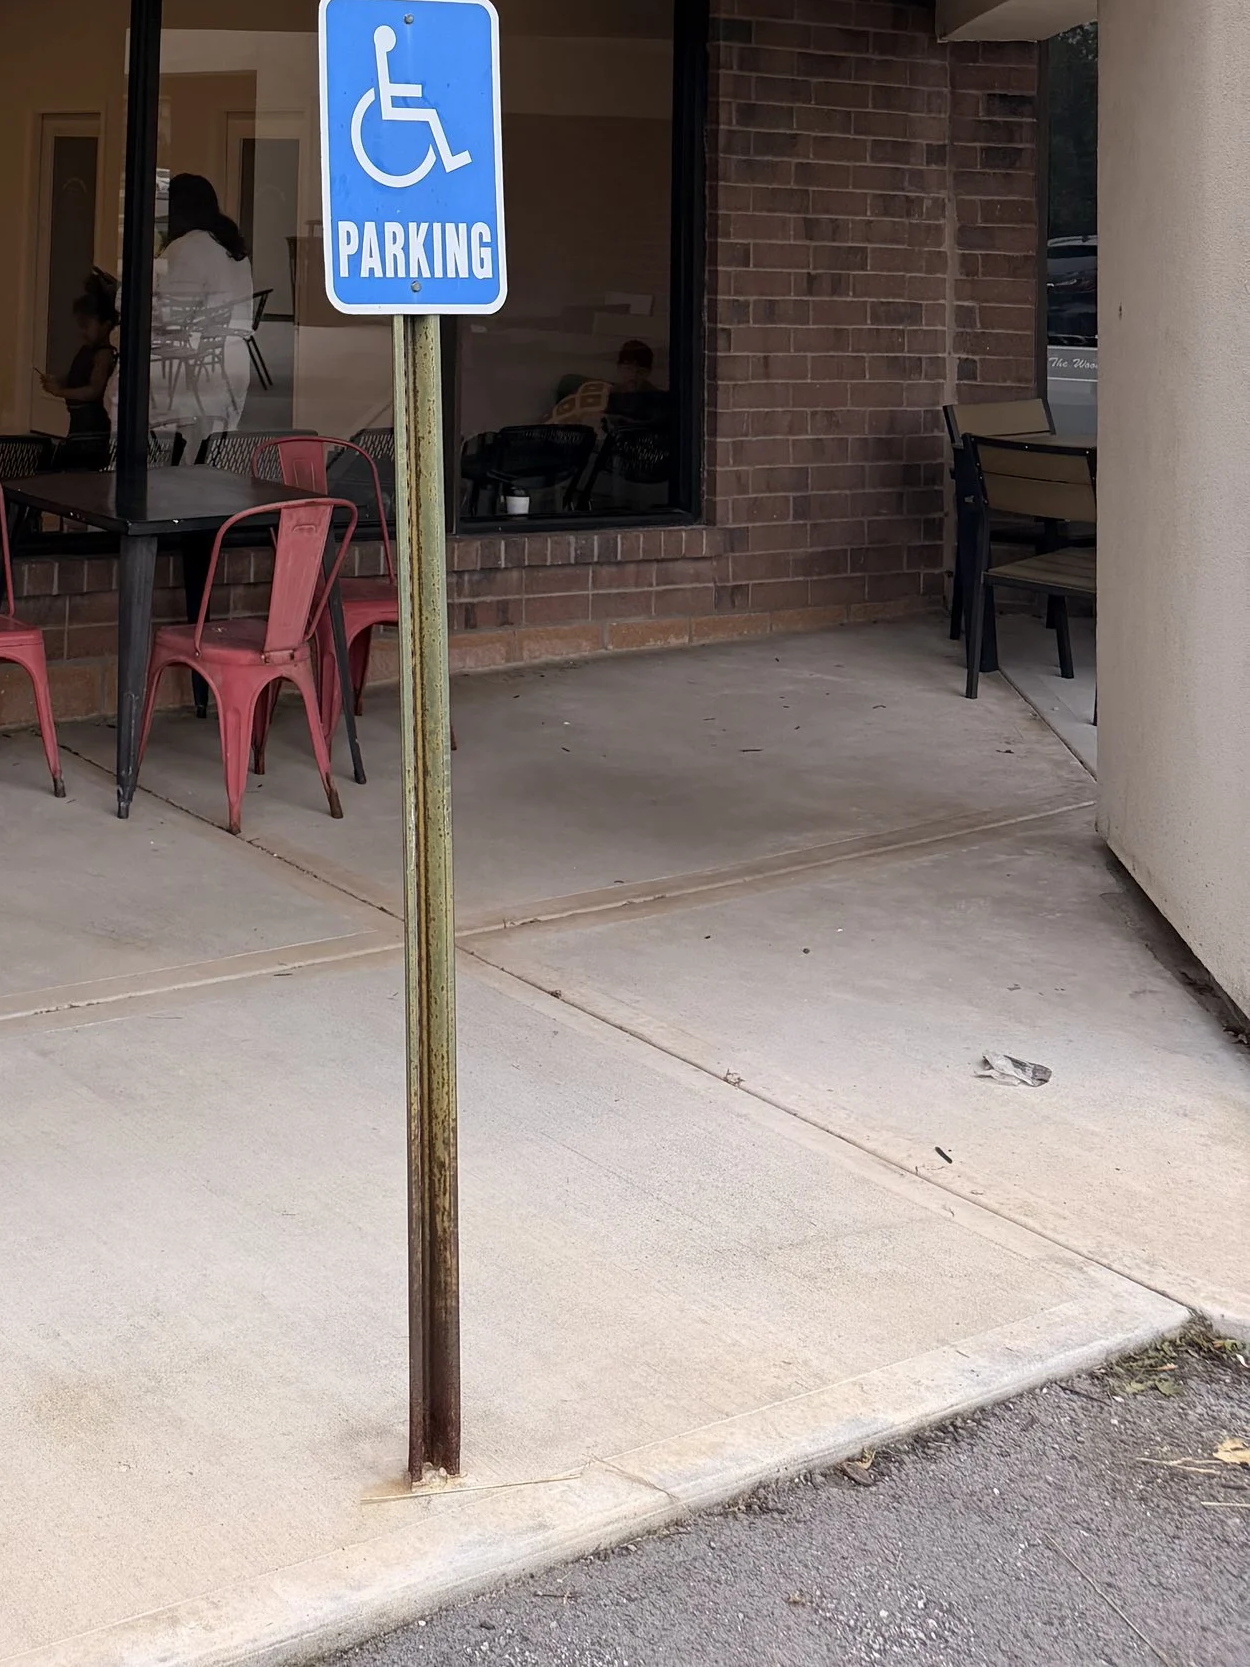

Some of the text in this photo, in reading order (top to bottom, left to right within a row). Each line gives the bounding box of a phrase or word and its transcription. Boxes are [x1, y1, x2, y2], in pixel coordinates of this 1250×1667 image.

[337, 220, 494, 280] PARKING
[1049, 357, 1098, 369] The Woo
